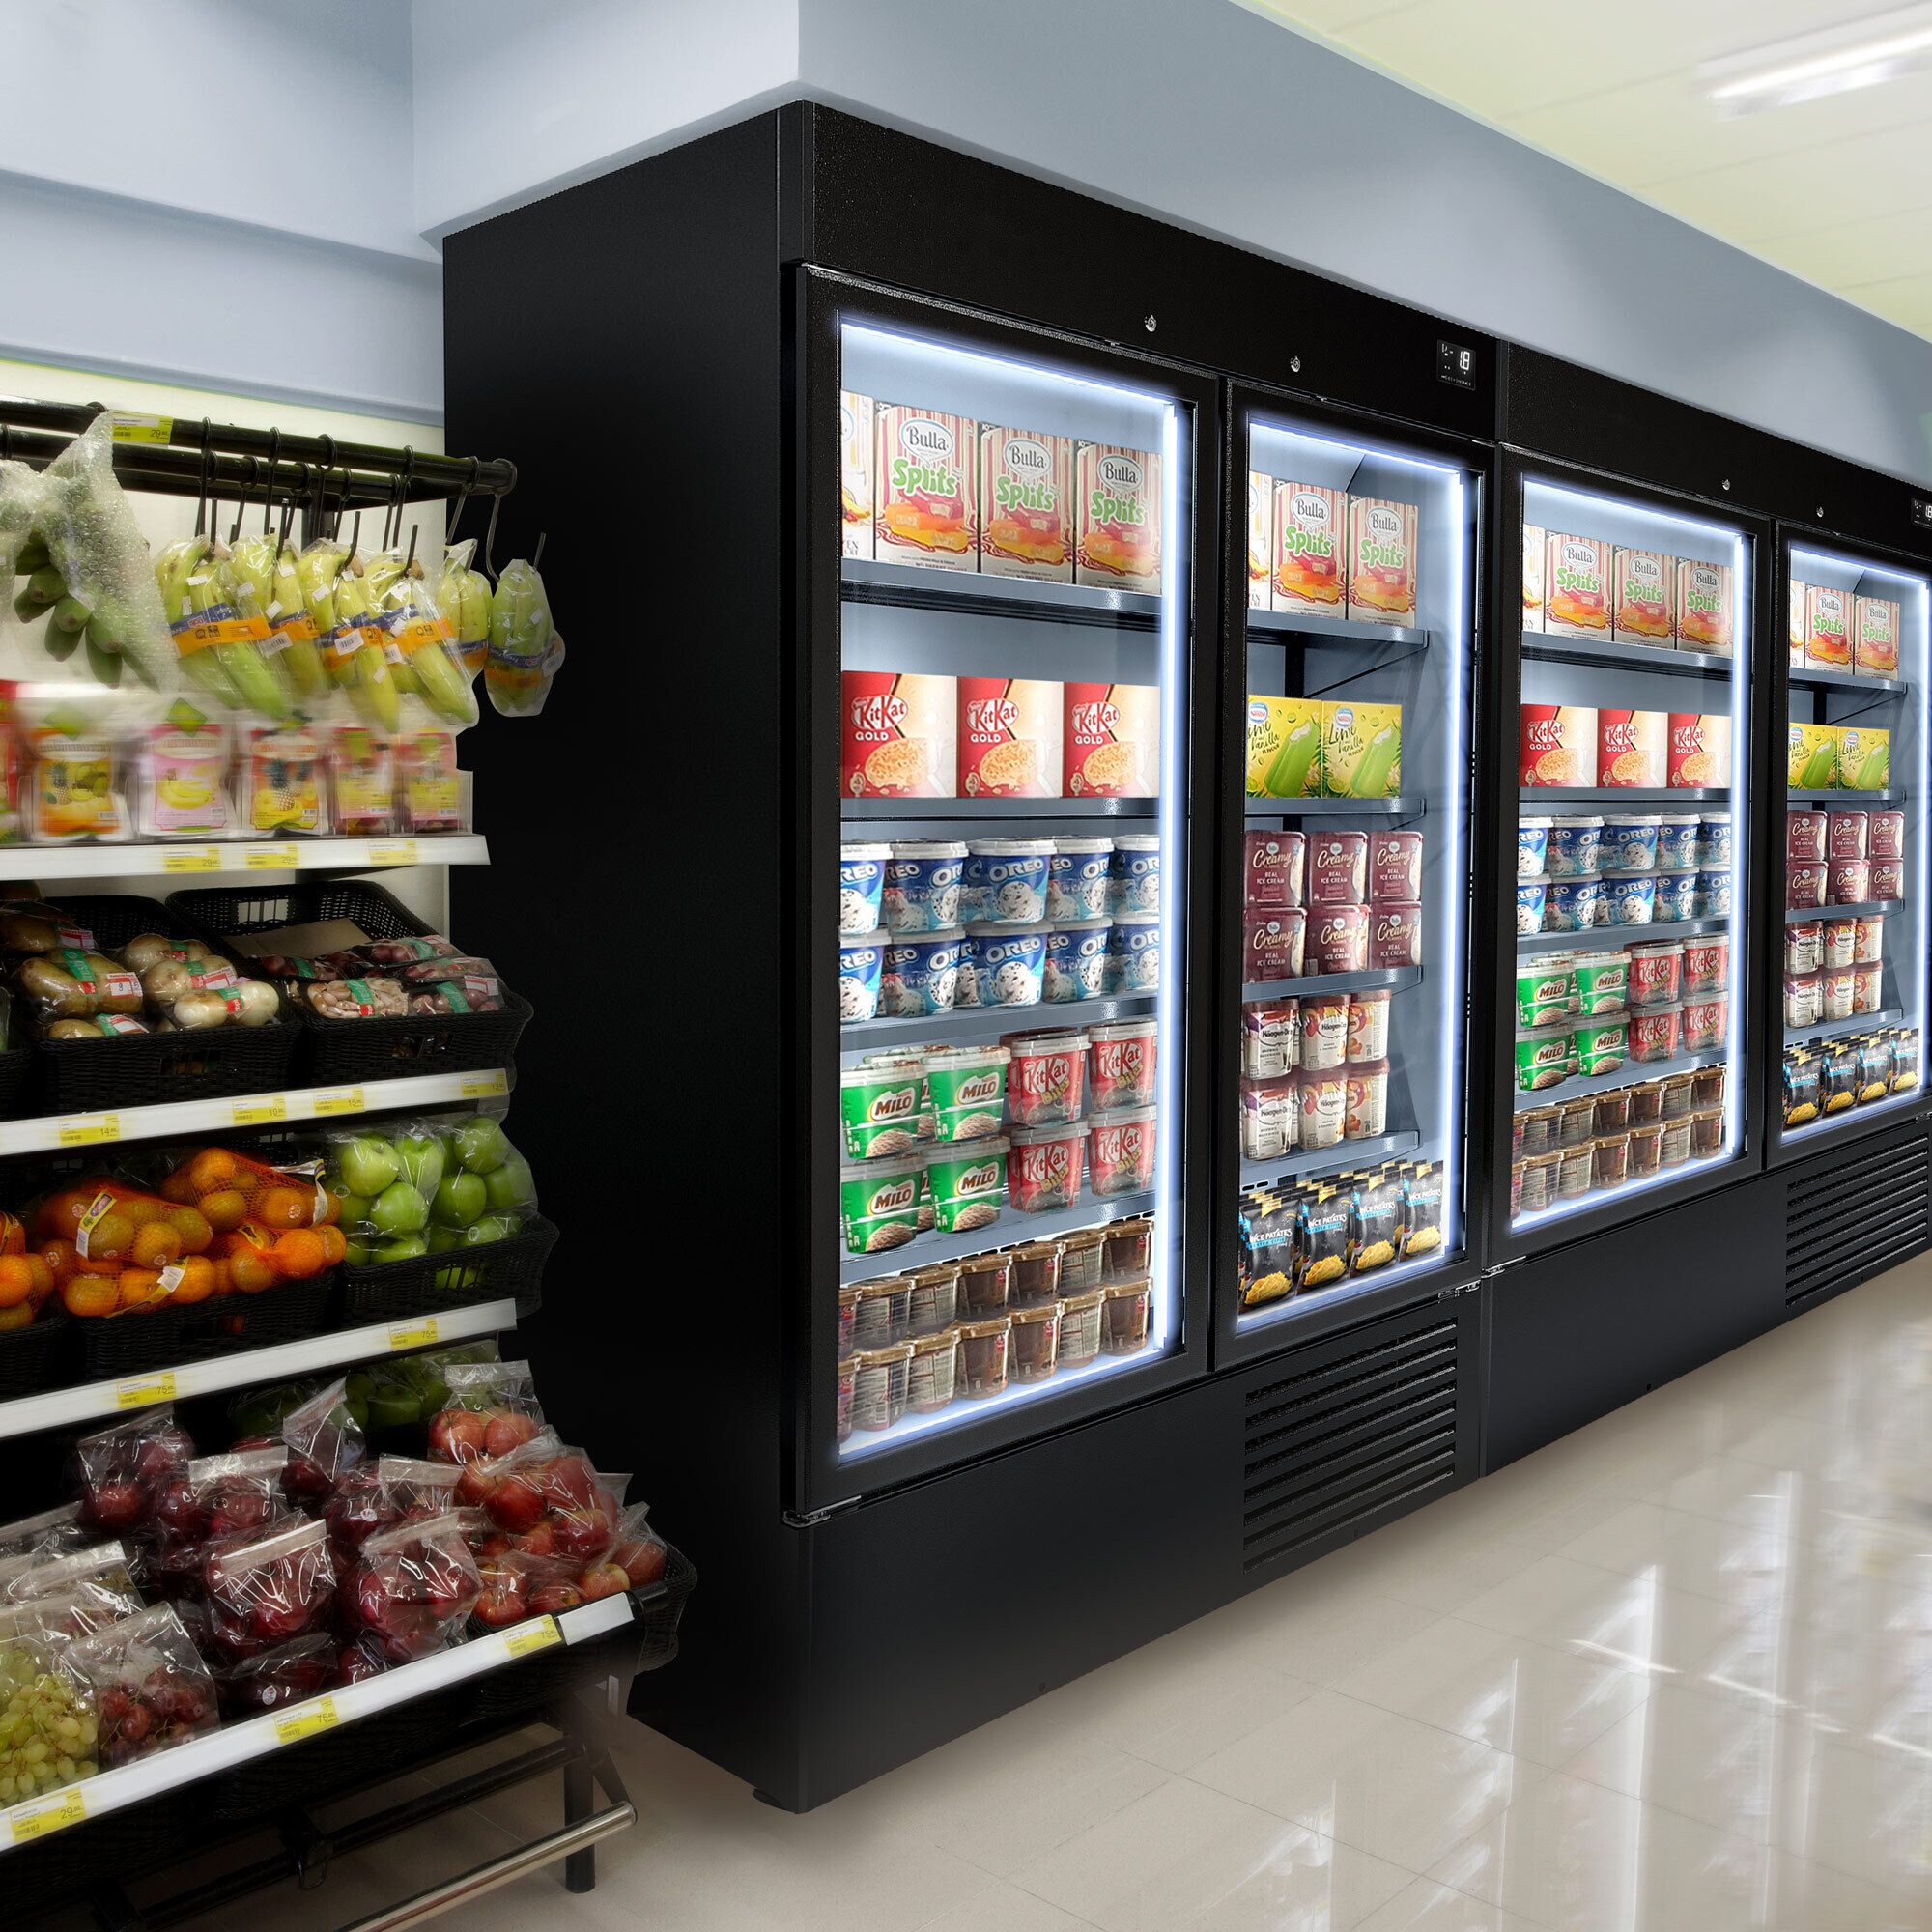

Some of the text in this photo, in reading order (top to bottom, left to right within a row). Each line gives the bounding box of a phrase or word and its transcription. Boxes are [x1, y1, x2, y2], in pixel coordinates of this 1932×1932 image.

[906, 425, 947, 451] Bulla
[1009, 444, 1045, 469] Bulla
[892, 458, 956, 496] Splits
[1103, 461, 1137, 484] Bulla
[996, 476, 1054, 510] Splits
[1091, 491, 1144, 524] Splits
[1294, 497, 1325, 520] Bulla
[1371, 512, 1398, 532] Bulla
[1285, 526, 1331, 555] Splits
[1360, 539, 1403, 567] Splits
[1566, 546, 1592, 563] Bulla
[1634, 560, 1658, 576] Bulla
[1556, 567, 1599, 592] Splits
[1694, 572, 1718, 586] Bulla
[1624, 581, 1662, 602] Splits
[1687, 590, 1721, 611] Splits
[1820, 597, 1840, 611] Bulla
[1868, 607, 1887, 619] Bulla
[1813, 614, 1844, 634] Splits
[857, 695, 904, 730] KitKat
[974, 697, 1018, 732] KitKat
[1078, 701, 1119, 734] KitKat
[855, 731, 889, 742] GOLD
[971, 733, 1002, 744] GOLD
[1075, 735, 1103, 745] GOLD
[1533, 721, 1563, 743] KitKat
[1608, 723, 1636, 745] KitKat
[1678, 725, 1703, 747] KitKat
[1519, 831, 1544, 841] REO
[1548, 831, 1572, 841] REO
[1618, 828, 1655, 843] OREO
[1253, 850, 1293, 868] Creamy
[1317, 850, 1354, 868] Creamy
[1377, 848, 1410, 867] Creamy
[840, 864, 877, 881] REO
[886, 865, 919, 880] REO
[989, 858, 1044, 881] OREO
[1518, 887, 1542, 899] REO
[1547, 886, 1569, 897] REO
[1615, 879, 1652, 895] OREO
[1253, 929, 1293, 950] Creamy
[1321, 925, 1356, 944] Creamy
[1377, 922, 1413, 941] Creamy
[840, 950, 876, 968] REO
[884, 949, 917, 966] REO
[985, 937, 1040, 963] OREO
[1690, 949, 1718, 972] KitKat
[1598, 975, 1622, 986] MILO
[1640, 959, 1669, 983] KitKat
[1539, 985, 1564, 998] MILO
[1690, 1005, 1718, 1029] KitKat
[1639, 1017, 1668, 1042] KitKat
[1597, 1034, 1621, 1047] MILO
[1101, 1042, 1141, 1078] KitKat
[1538, 1046, 1564, 1061] MILO
[1026, 1057, 1066, 1094] KitKat
[961, 1080, 996, 1099] MILO
[874, 1095, 912, 1116] MILO
[1101, 1126, 1140, 1164] KitKat
[1025, 1145, 1066, 1182] KitKat
[961, 1170, 996, 1190] MILO
[874, 1190, 912, 1209] MILO
